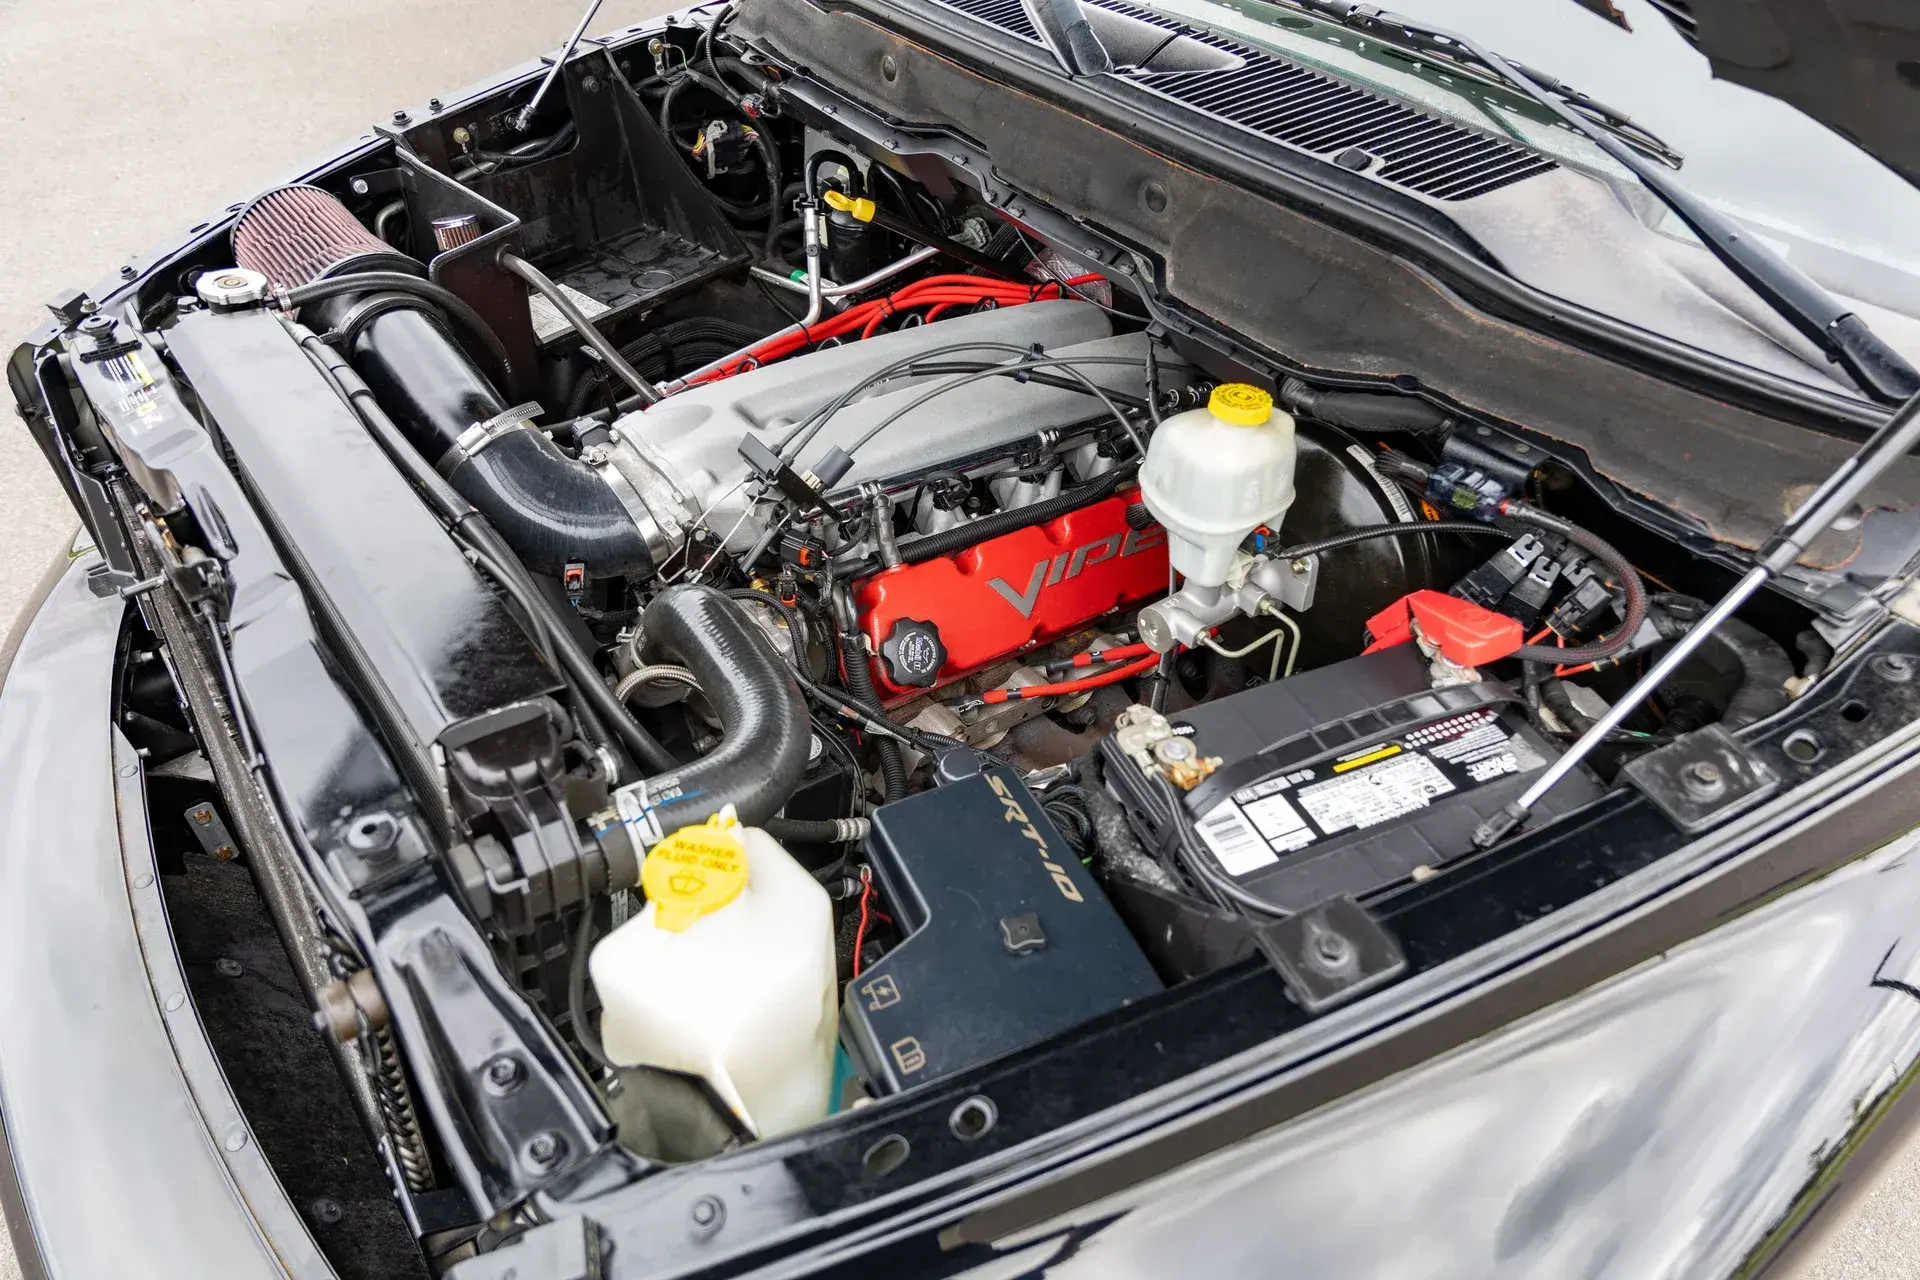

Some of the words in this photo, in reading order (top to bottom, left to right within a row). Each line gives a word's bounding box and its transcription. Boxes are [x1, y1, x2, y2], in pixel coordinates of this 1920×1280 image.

[985, 527, 1168, 620] VIPE
[657, 848, 698, 864] FLUID
[702, 858, 739, 872] ONLY
[674, 840, 735, 858] WASHER
[983, 773, 1084, 903] SRT-10
